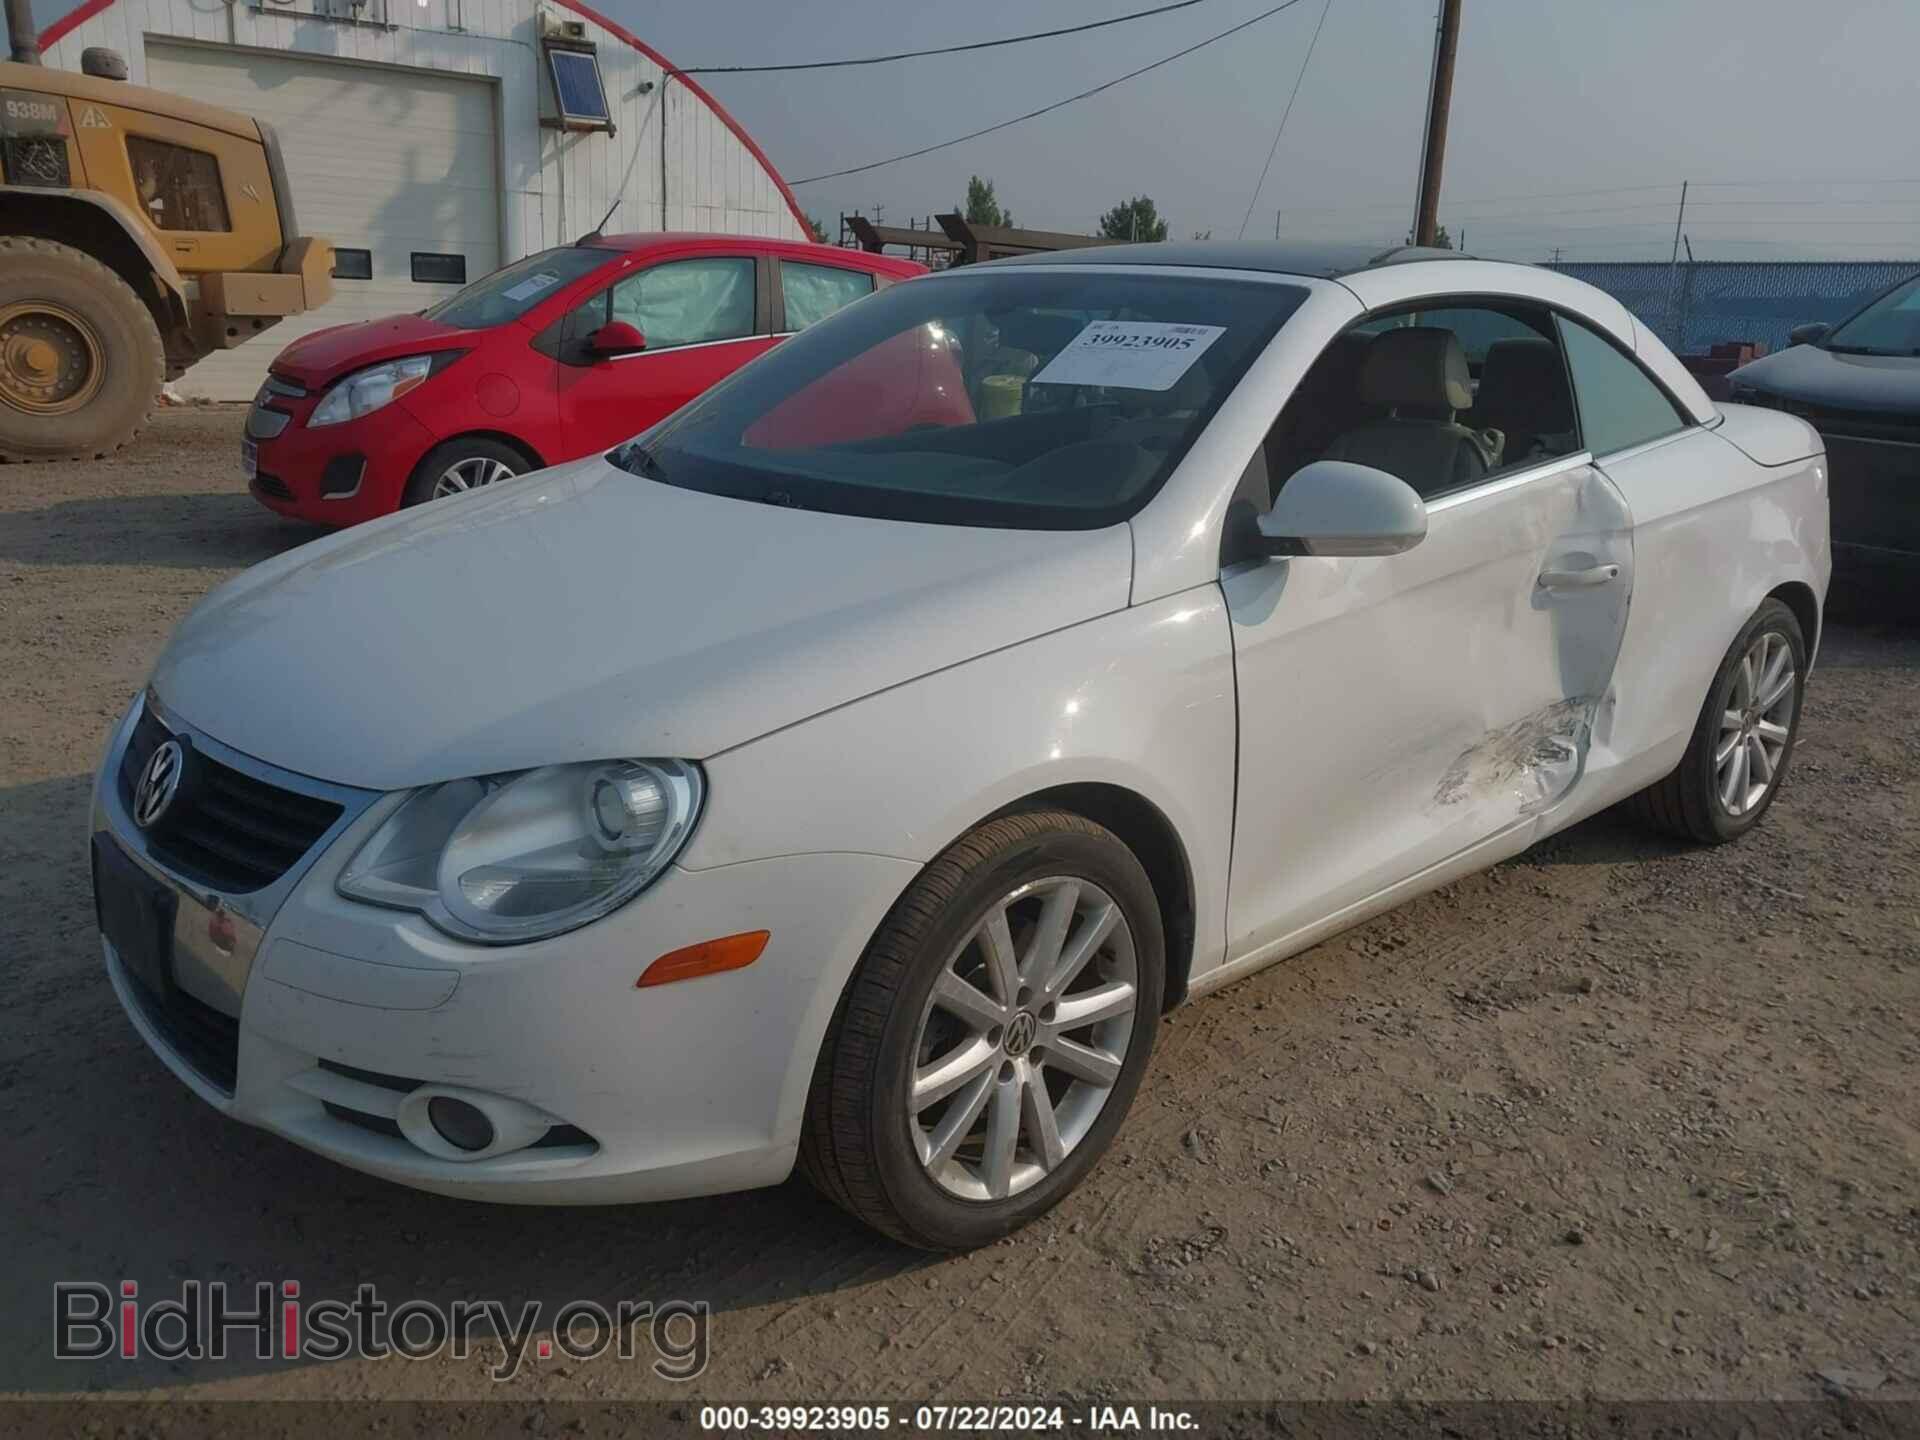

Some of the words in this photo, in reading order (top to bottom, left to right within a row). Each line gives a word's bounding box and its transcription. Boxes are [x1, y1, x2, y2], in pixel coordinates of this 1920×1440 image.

[6, 100, 57, 120] 938M
[1082, 333, 1196, 351] 39923905
[134, 741, 182, 826] VW
